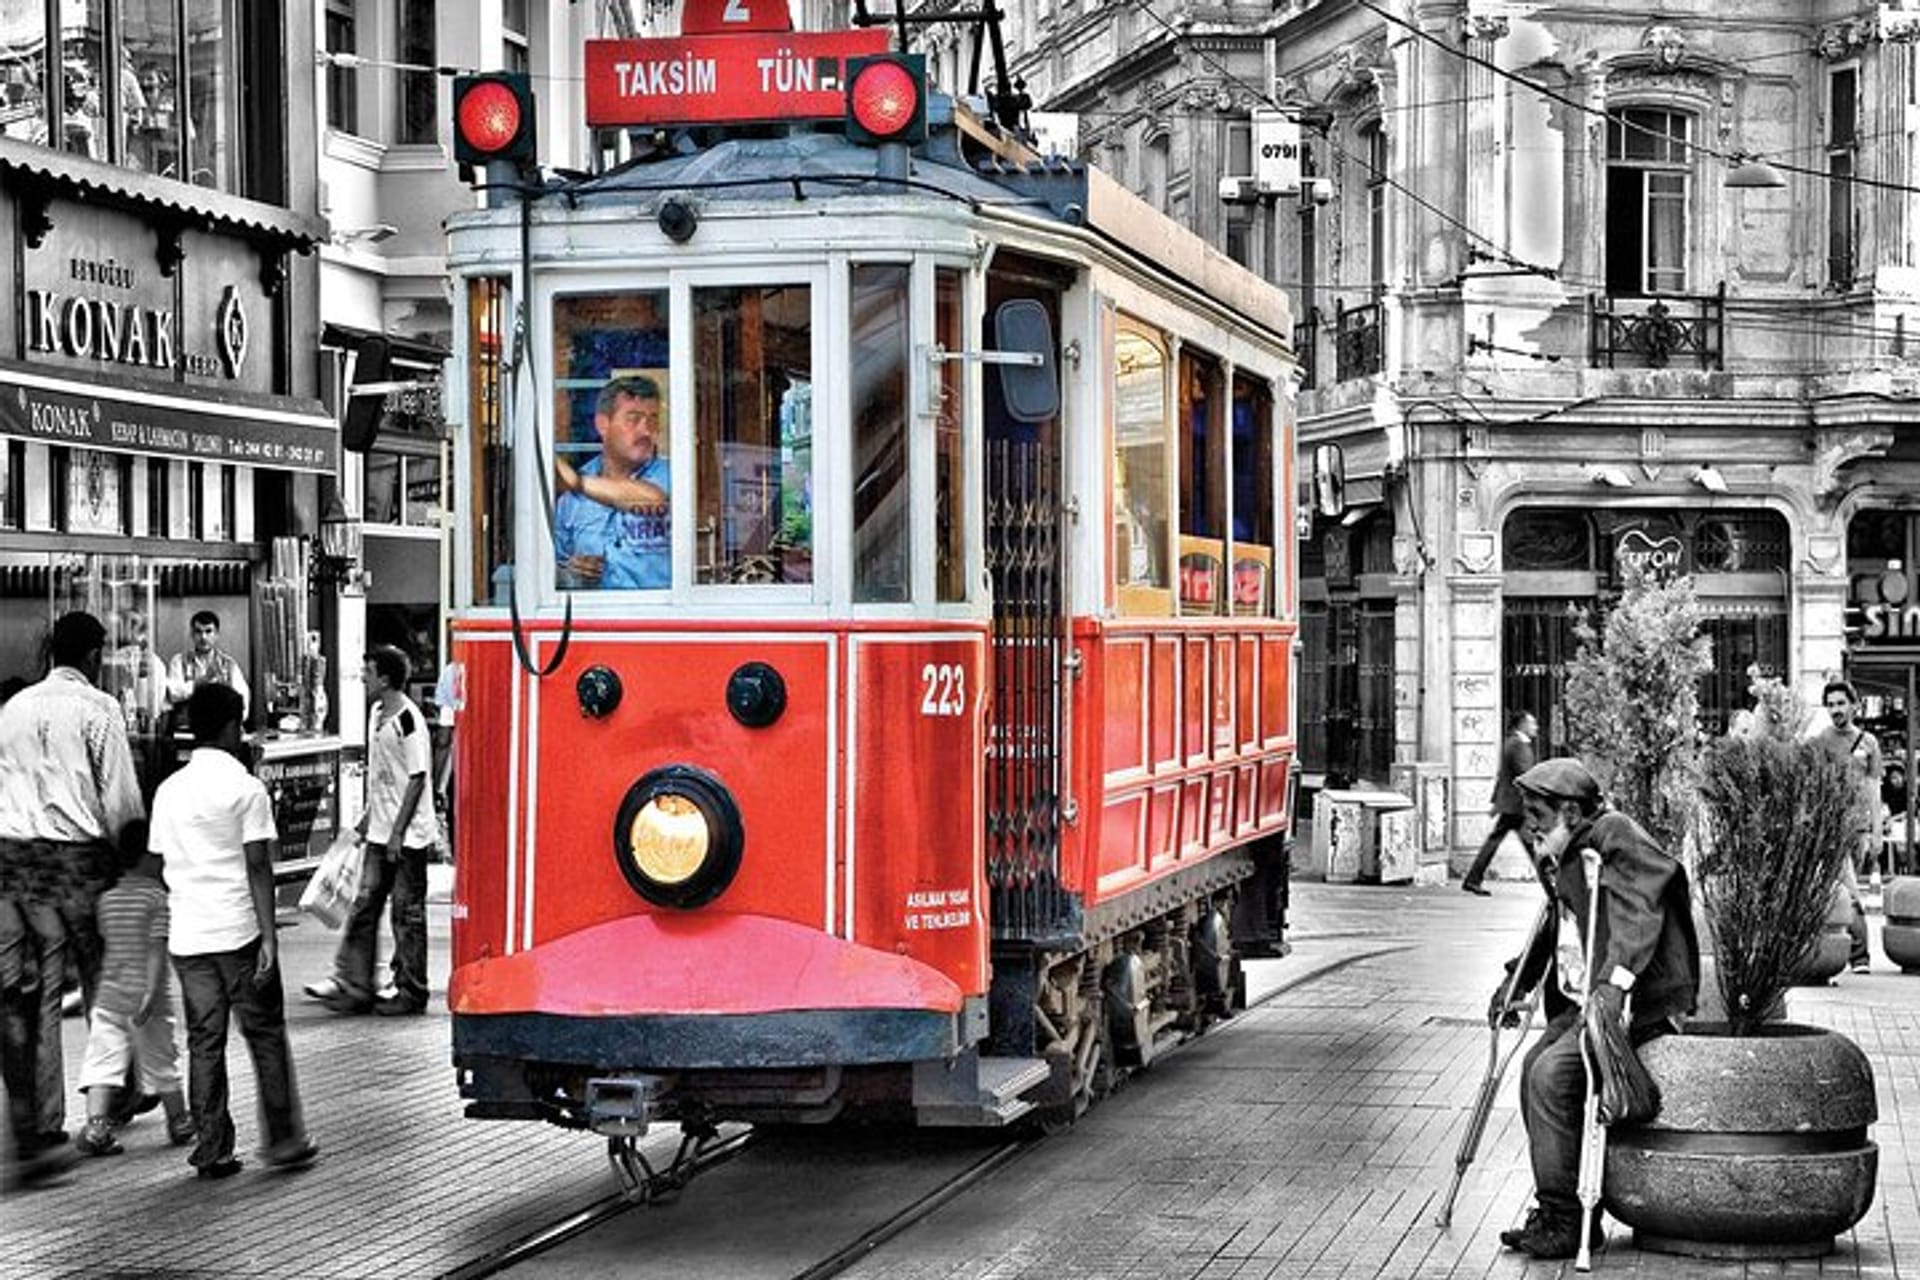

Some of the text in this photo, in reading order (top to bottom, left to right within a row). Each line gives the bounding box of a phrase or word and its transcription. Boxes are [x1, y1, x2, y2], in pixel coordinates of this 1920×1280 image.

[614, 52, 717, 97] TAKSİM
[757, 49, 845, 93] TÜN
[30, 290, 176, 368] KONAK
[31, 401, 92, 438] KONAK
[920, 663, 965, 716] 223
